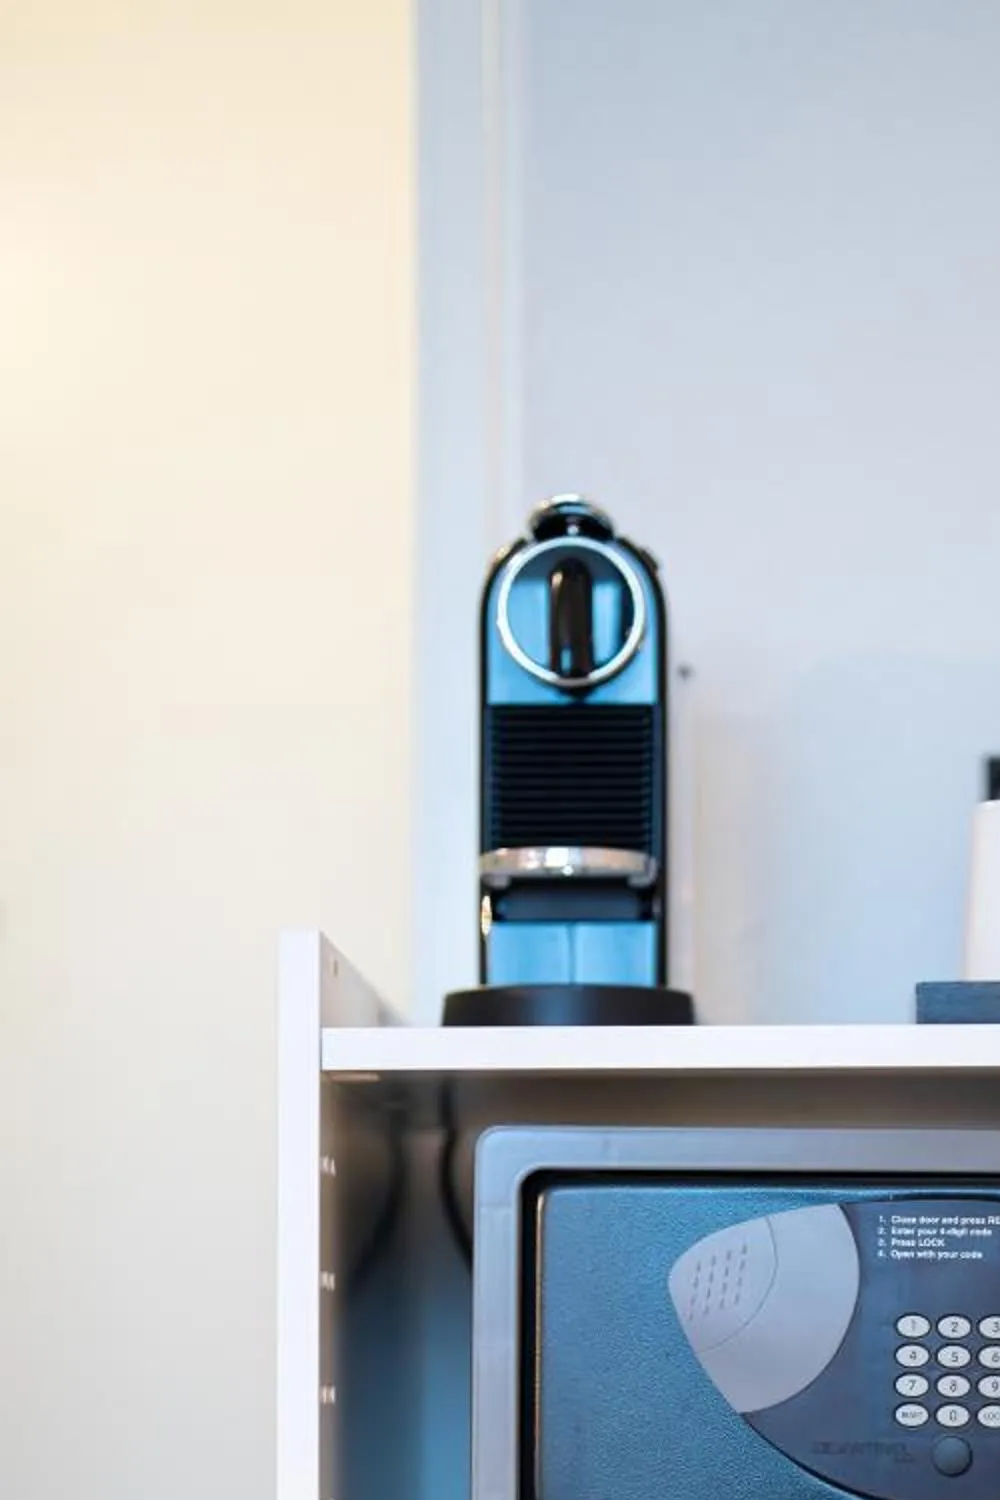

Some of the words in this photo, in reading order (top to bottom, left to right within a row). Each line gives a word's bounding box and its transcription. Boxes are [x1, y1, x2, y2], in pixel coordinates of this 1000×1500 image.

[891, 1215, 917, 1225] Close
[918, 1215, 940, 1225] door
[941, 1215, 959, 1225] and
[960, 1216, 985, 1227] press
[891, 1226, 914, 1236] Enter
[917, 1228, 938, 1238] your
[969, 1227, 993, 1237] code
[891, 1238, 916, 1247] Press
[917, 1238, 945, 1247] LOCK
[890, 1249, 914, 1260] Open
[917, 1249, 937, 1259] with
[937, 1250, 959, 1261] your
[960, 1250, 983, 1260] code
[951, 1321, 959, 1333] 2
[991, 1321, 1000, 1333] 3
[909, 1350, 917, 1361] 4
[951, 1351, 959, 1363] 5
[991, 1352, 1000, 1363] 6
[908, 1379, 917, 1391] 7
[949, 1380, 957, 1393] 8
[991, 1380, 999, 1392] 9
[949, 1409, 957, 1422] 0
